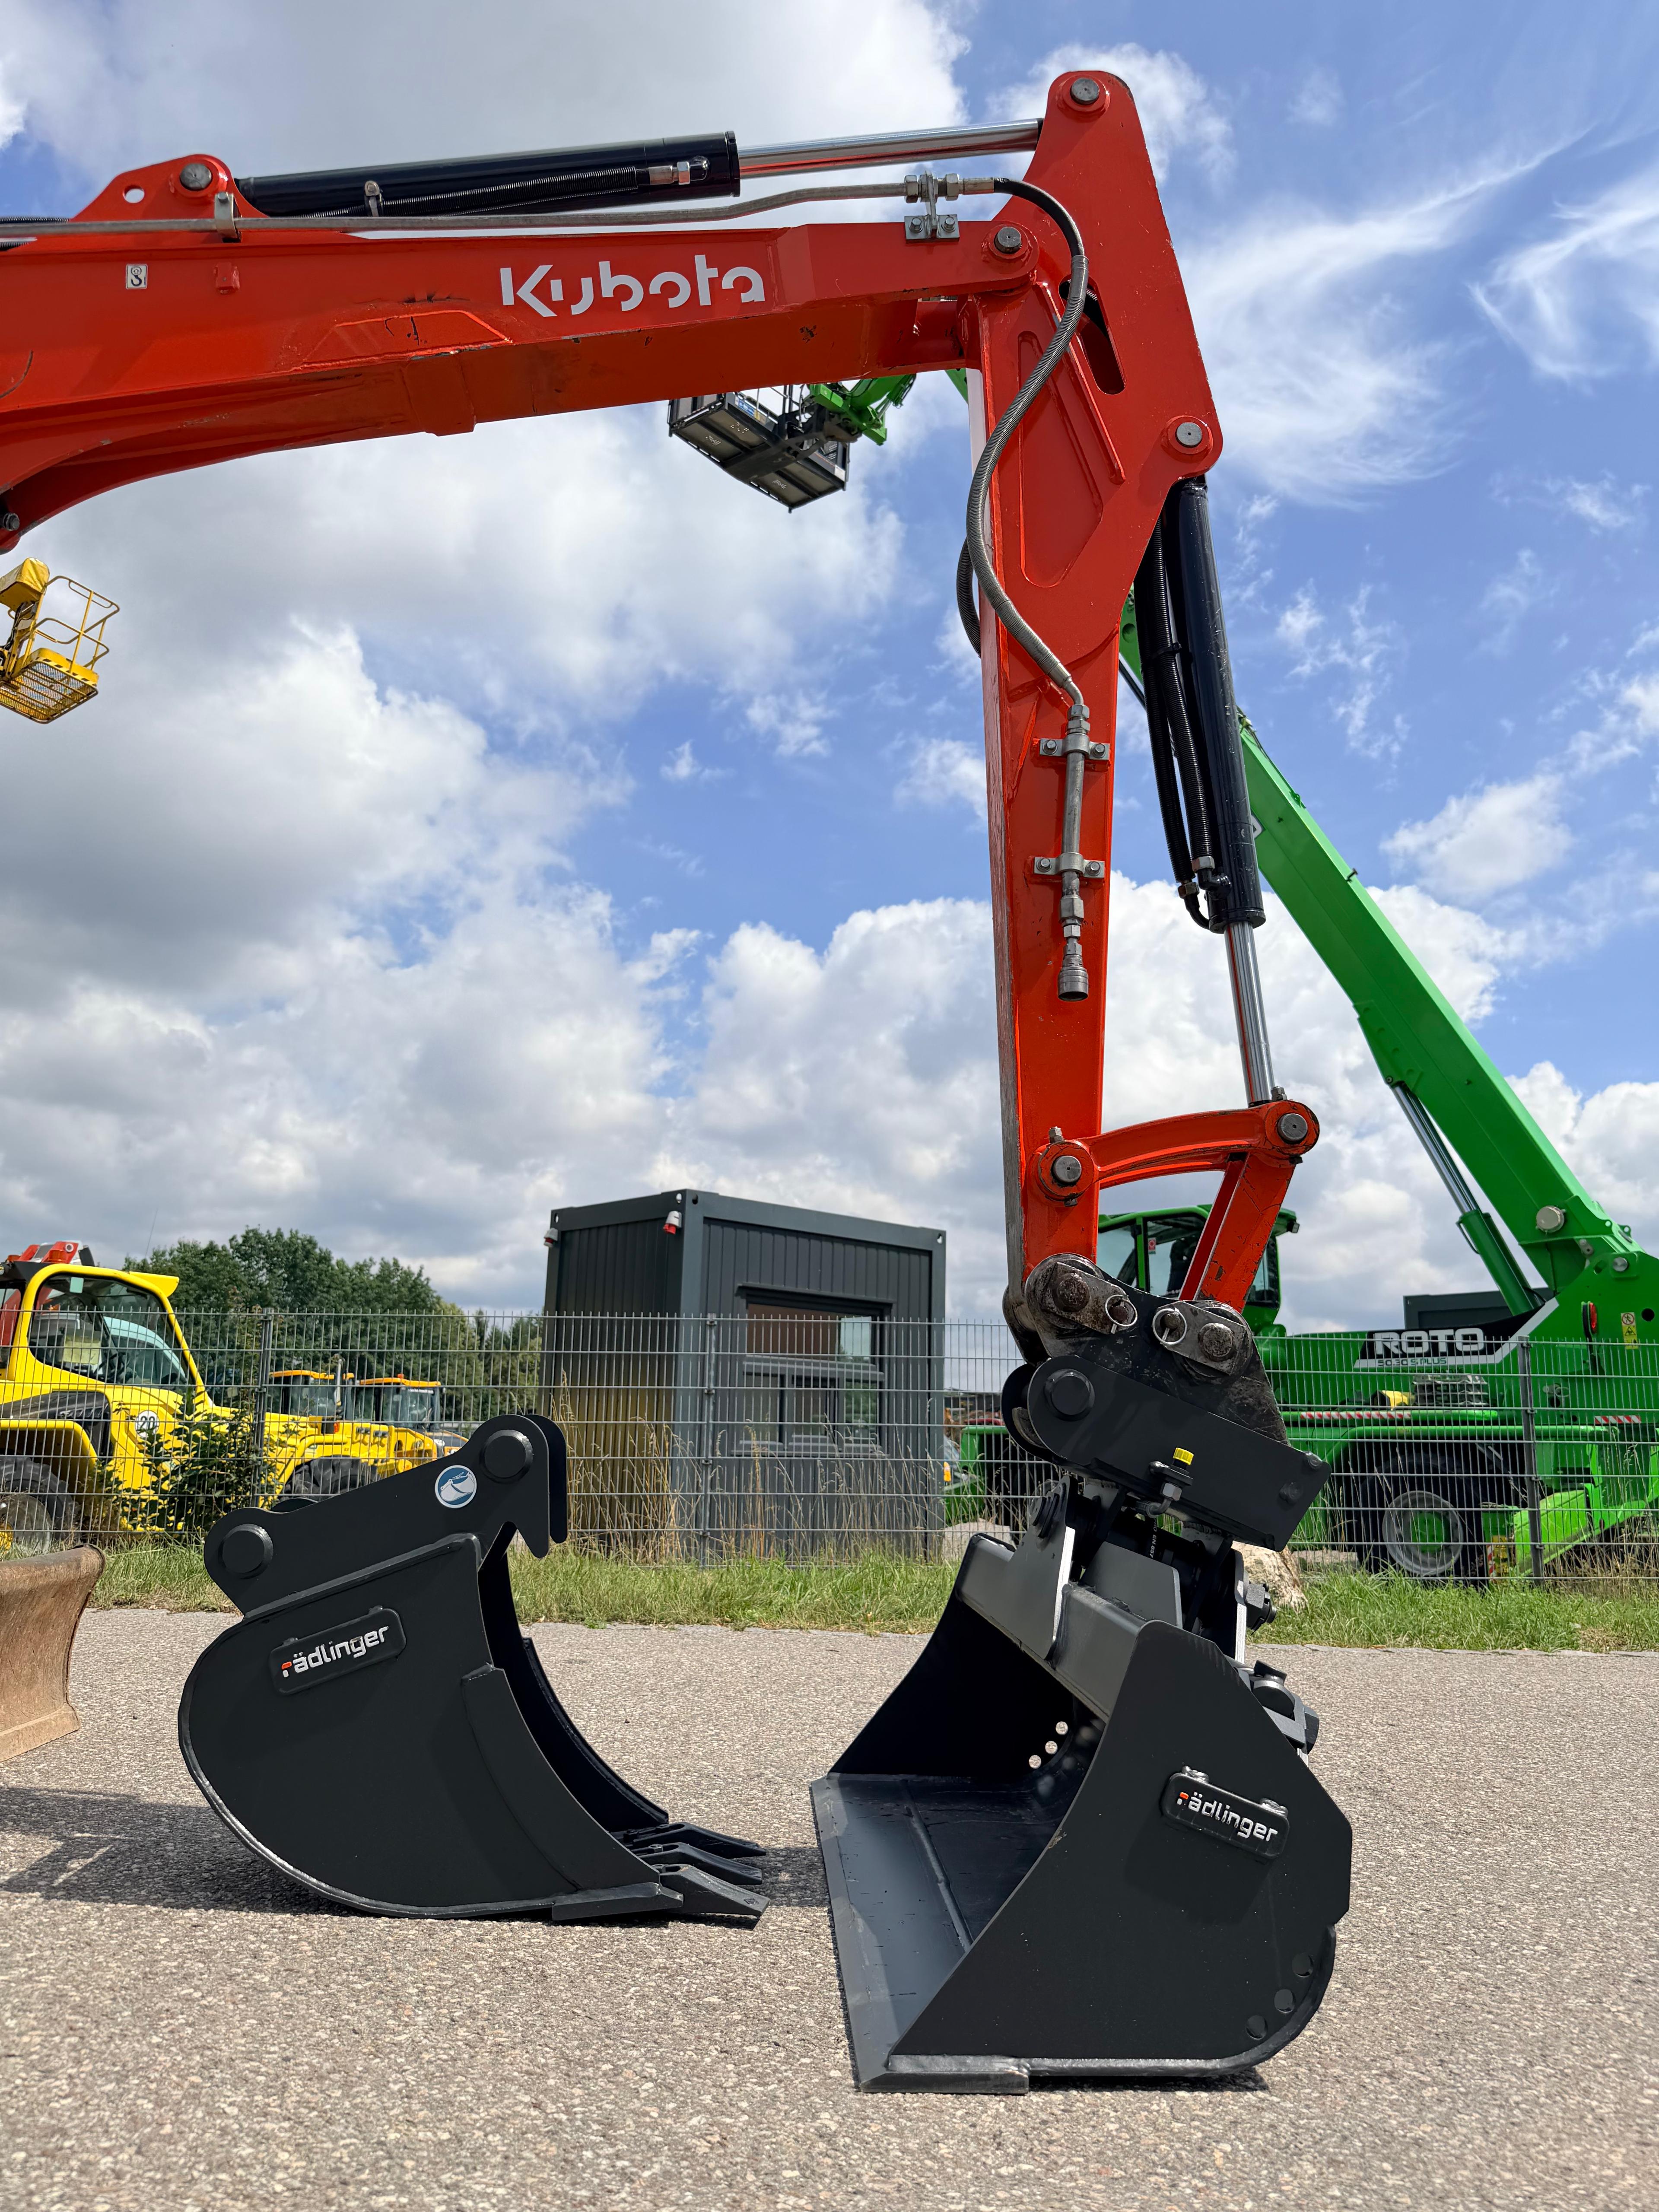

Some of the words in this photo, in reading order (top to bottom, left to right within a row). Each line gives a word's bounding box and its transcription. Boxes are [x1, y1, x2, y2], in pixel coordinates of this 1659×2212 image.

[500, 254, 765, 318] Kubota
[1374, 1328, 1484, 1355] ROTO
[140, 1416, 156, 1430] 20
[281, 1626, 389, 1678] rädlinger
[1176, 1792, 1278, 1842] rädlinger
